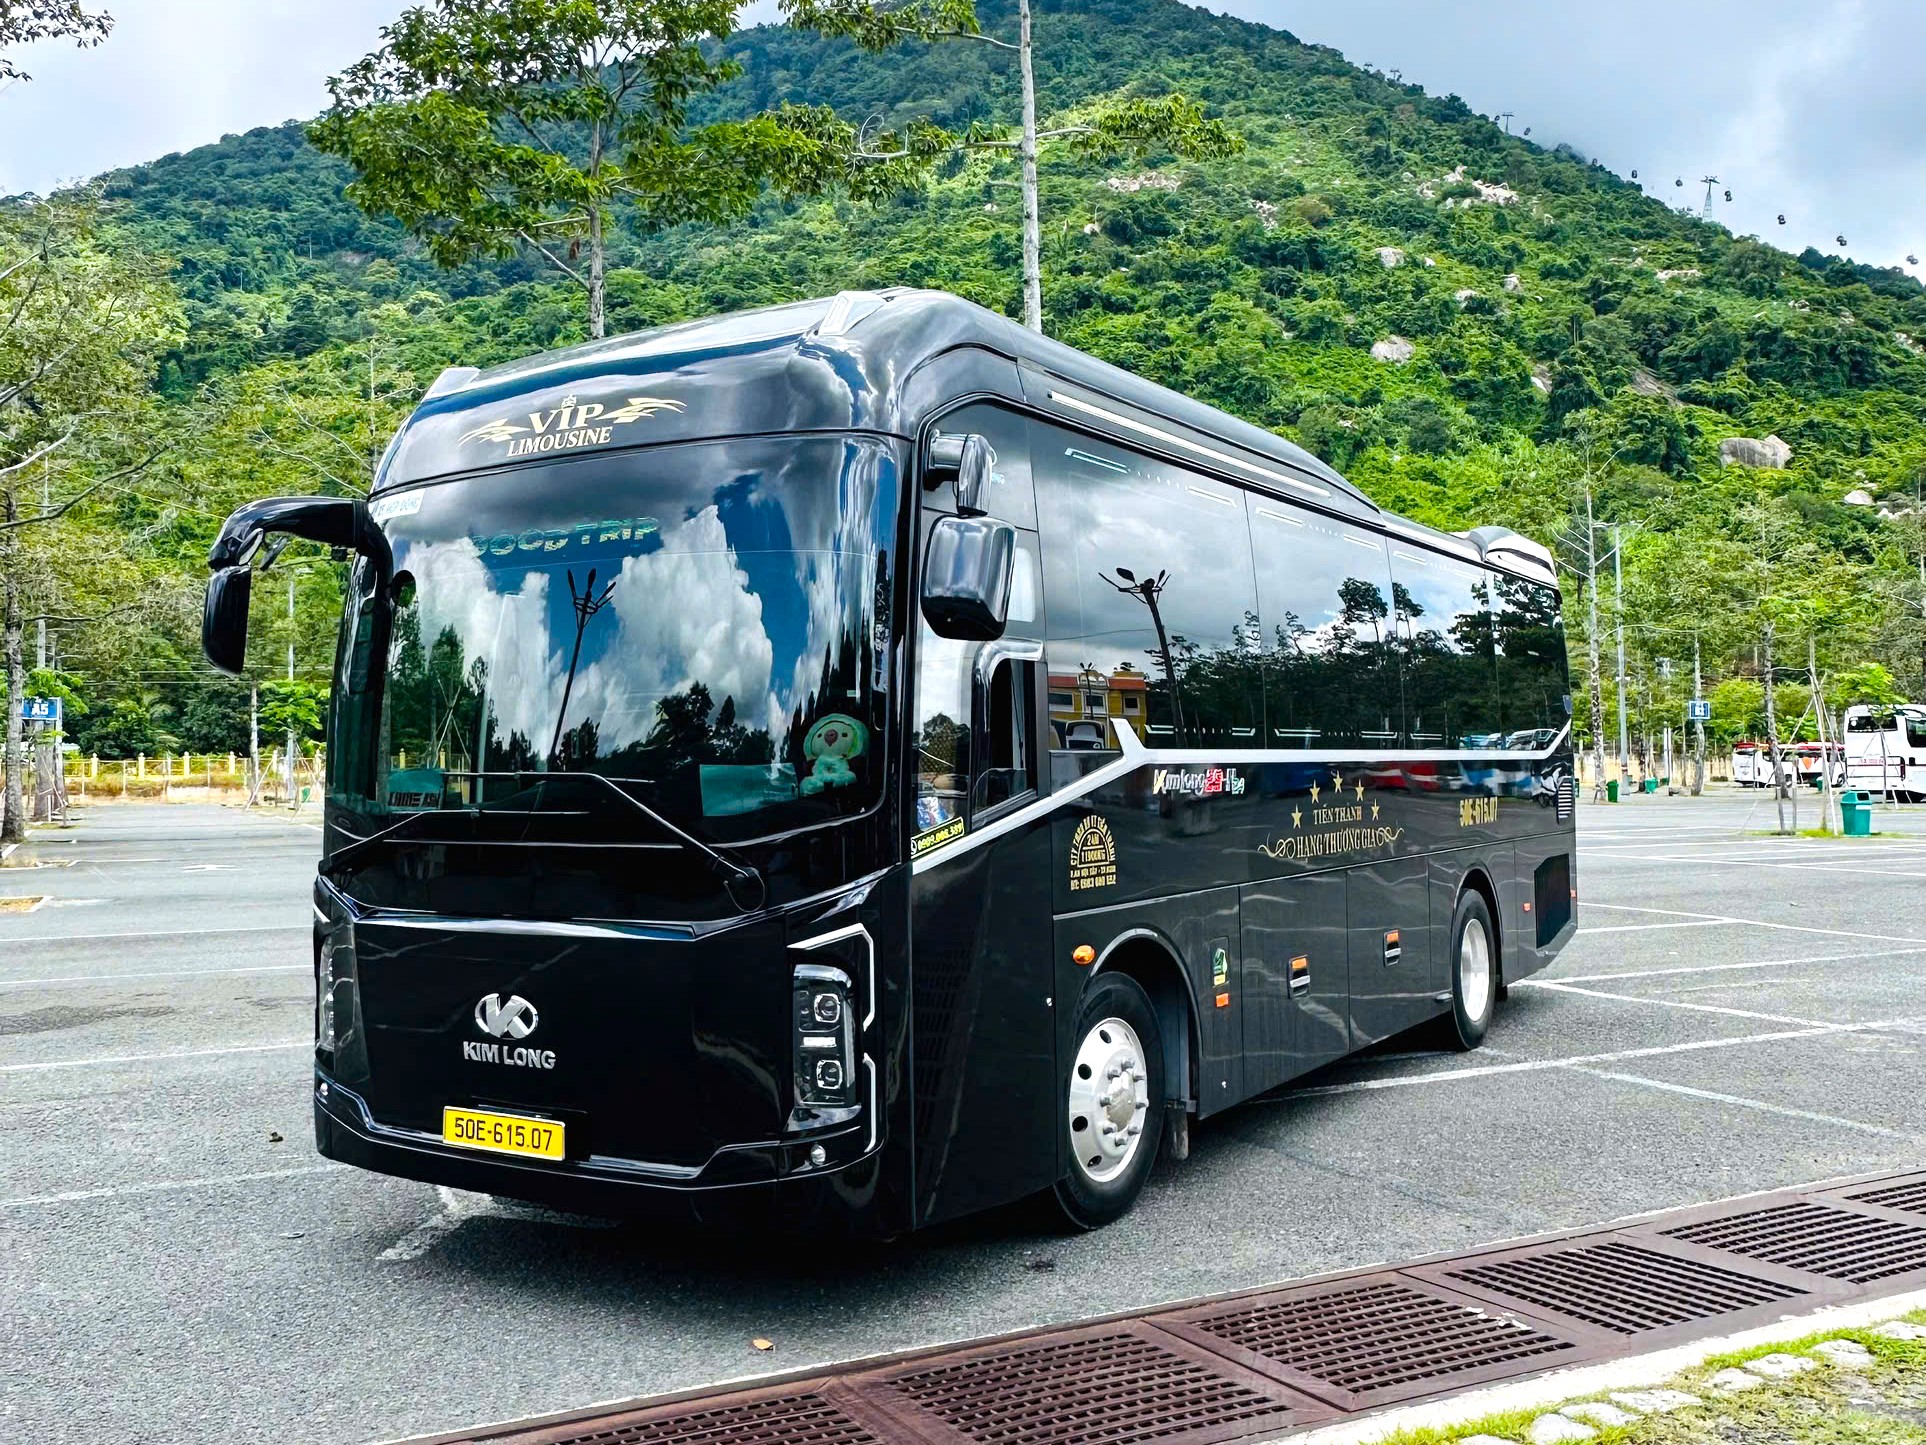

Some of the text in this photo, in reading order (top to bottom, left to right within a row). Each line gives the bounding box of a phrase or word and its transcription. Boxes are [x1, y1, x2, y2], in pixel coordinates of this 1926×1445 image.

[528, 403, 604, 434] VIP
[506, 426, 613, 457] LIMOUSINE
[32, 703, 48, 715] A5
[1361, 827, 1376, 849] GIA
[463, 1041, 556, 1069] KIM LONG
[455, 1117, 552, 1151] 50E-615.07
